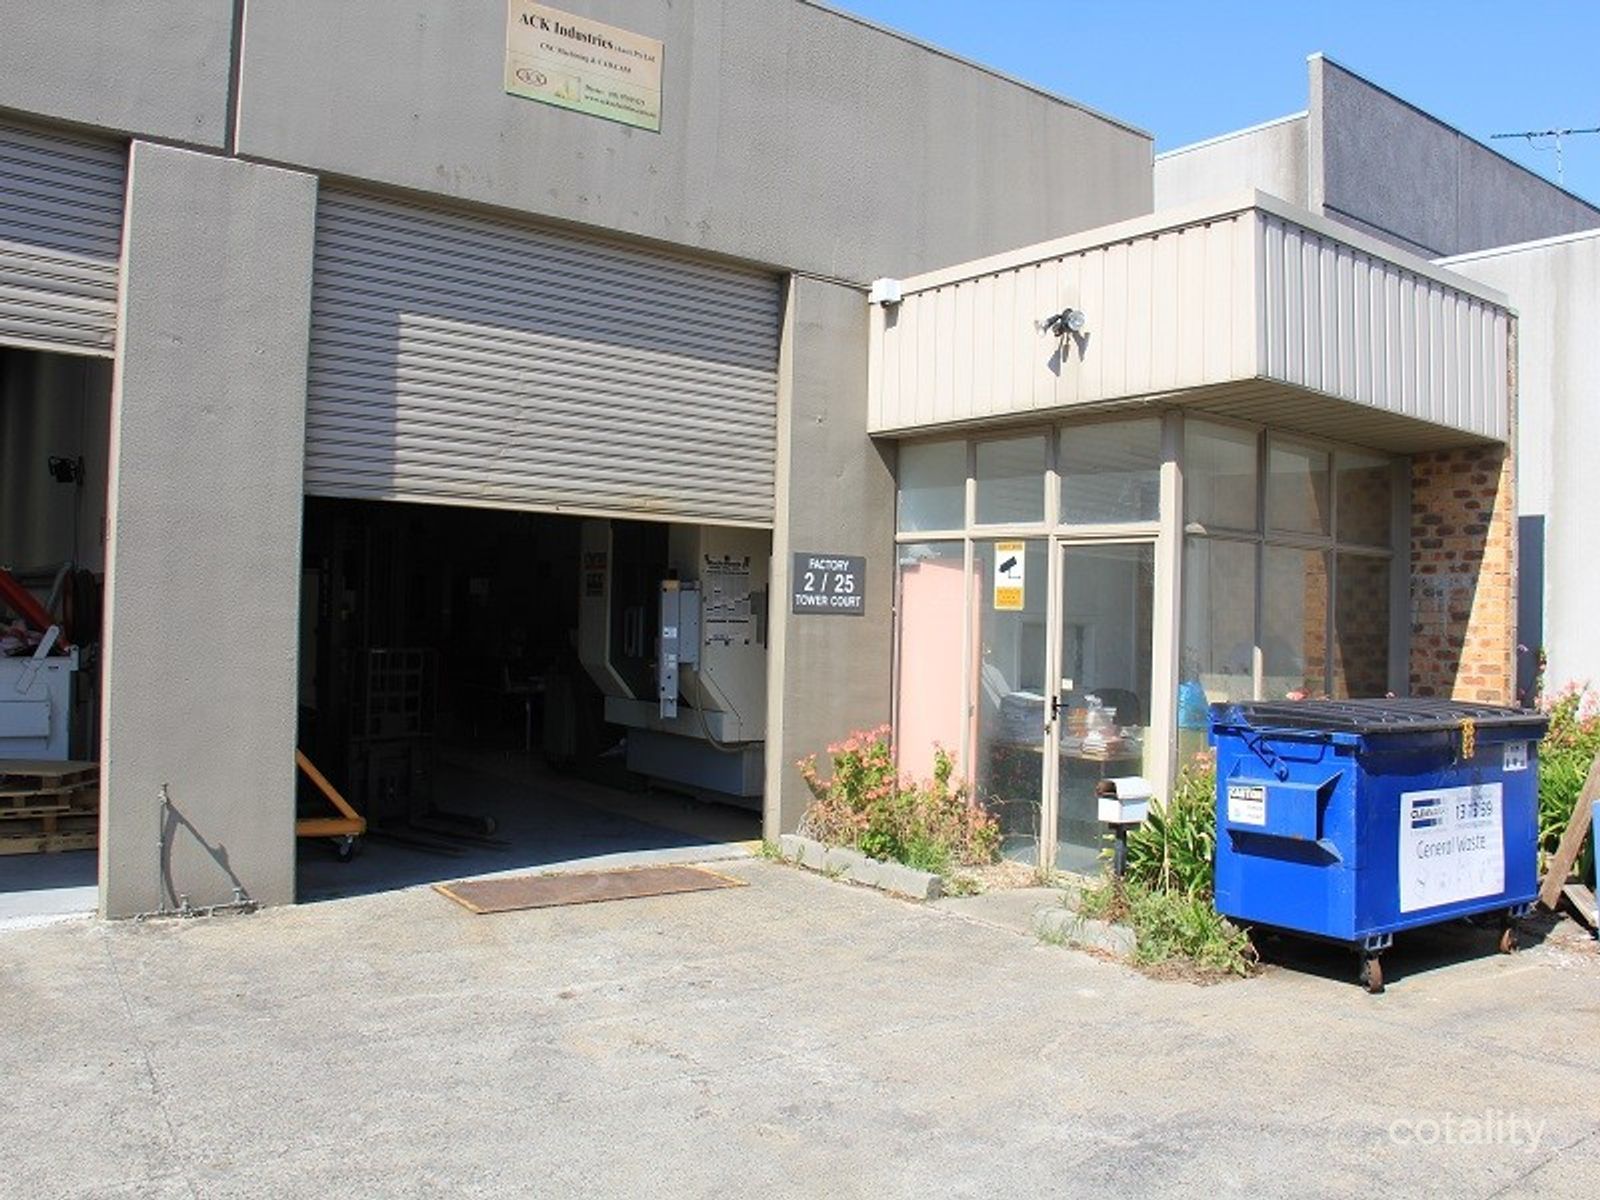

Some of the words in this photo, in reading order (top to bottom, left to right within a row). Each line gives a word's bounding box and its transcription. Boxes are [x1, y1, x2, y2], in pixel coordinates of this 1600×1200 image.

[519, 13, 550, 32] ACK
[554, 22, 614, 49] Industries
[809, 558, 849, 571] FACTORY
[804, 572, 815, 591] 2
[834, 574, 855, 593] 25
[795, 594, 828, 606] TOWER
[830, 596, 861, 607] COURT
[1416, 836, 1455, 860] General
[1457, 835, 1487, 853] Waste
